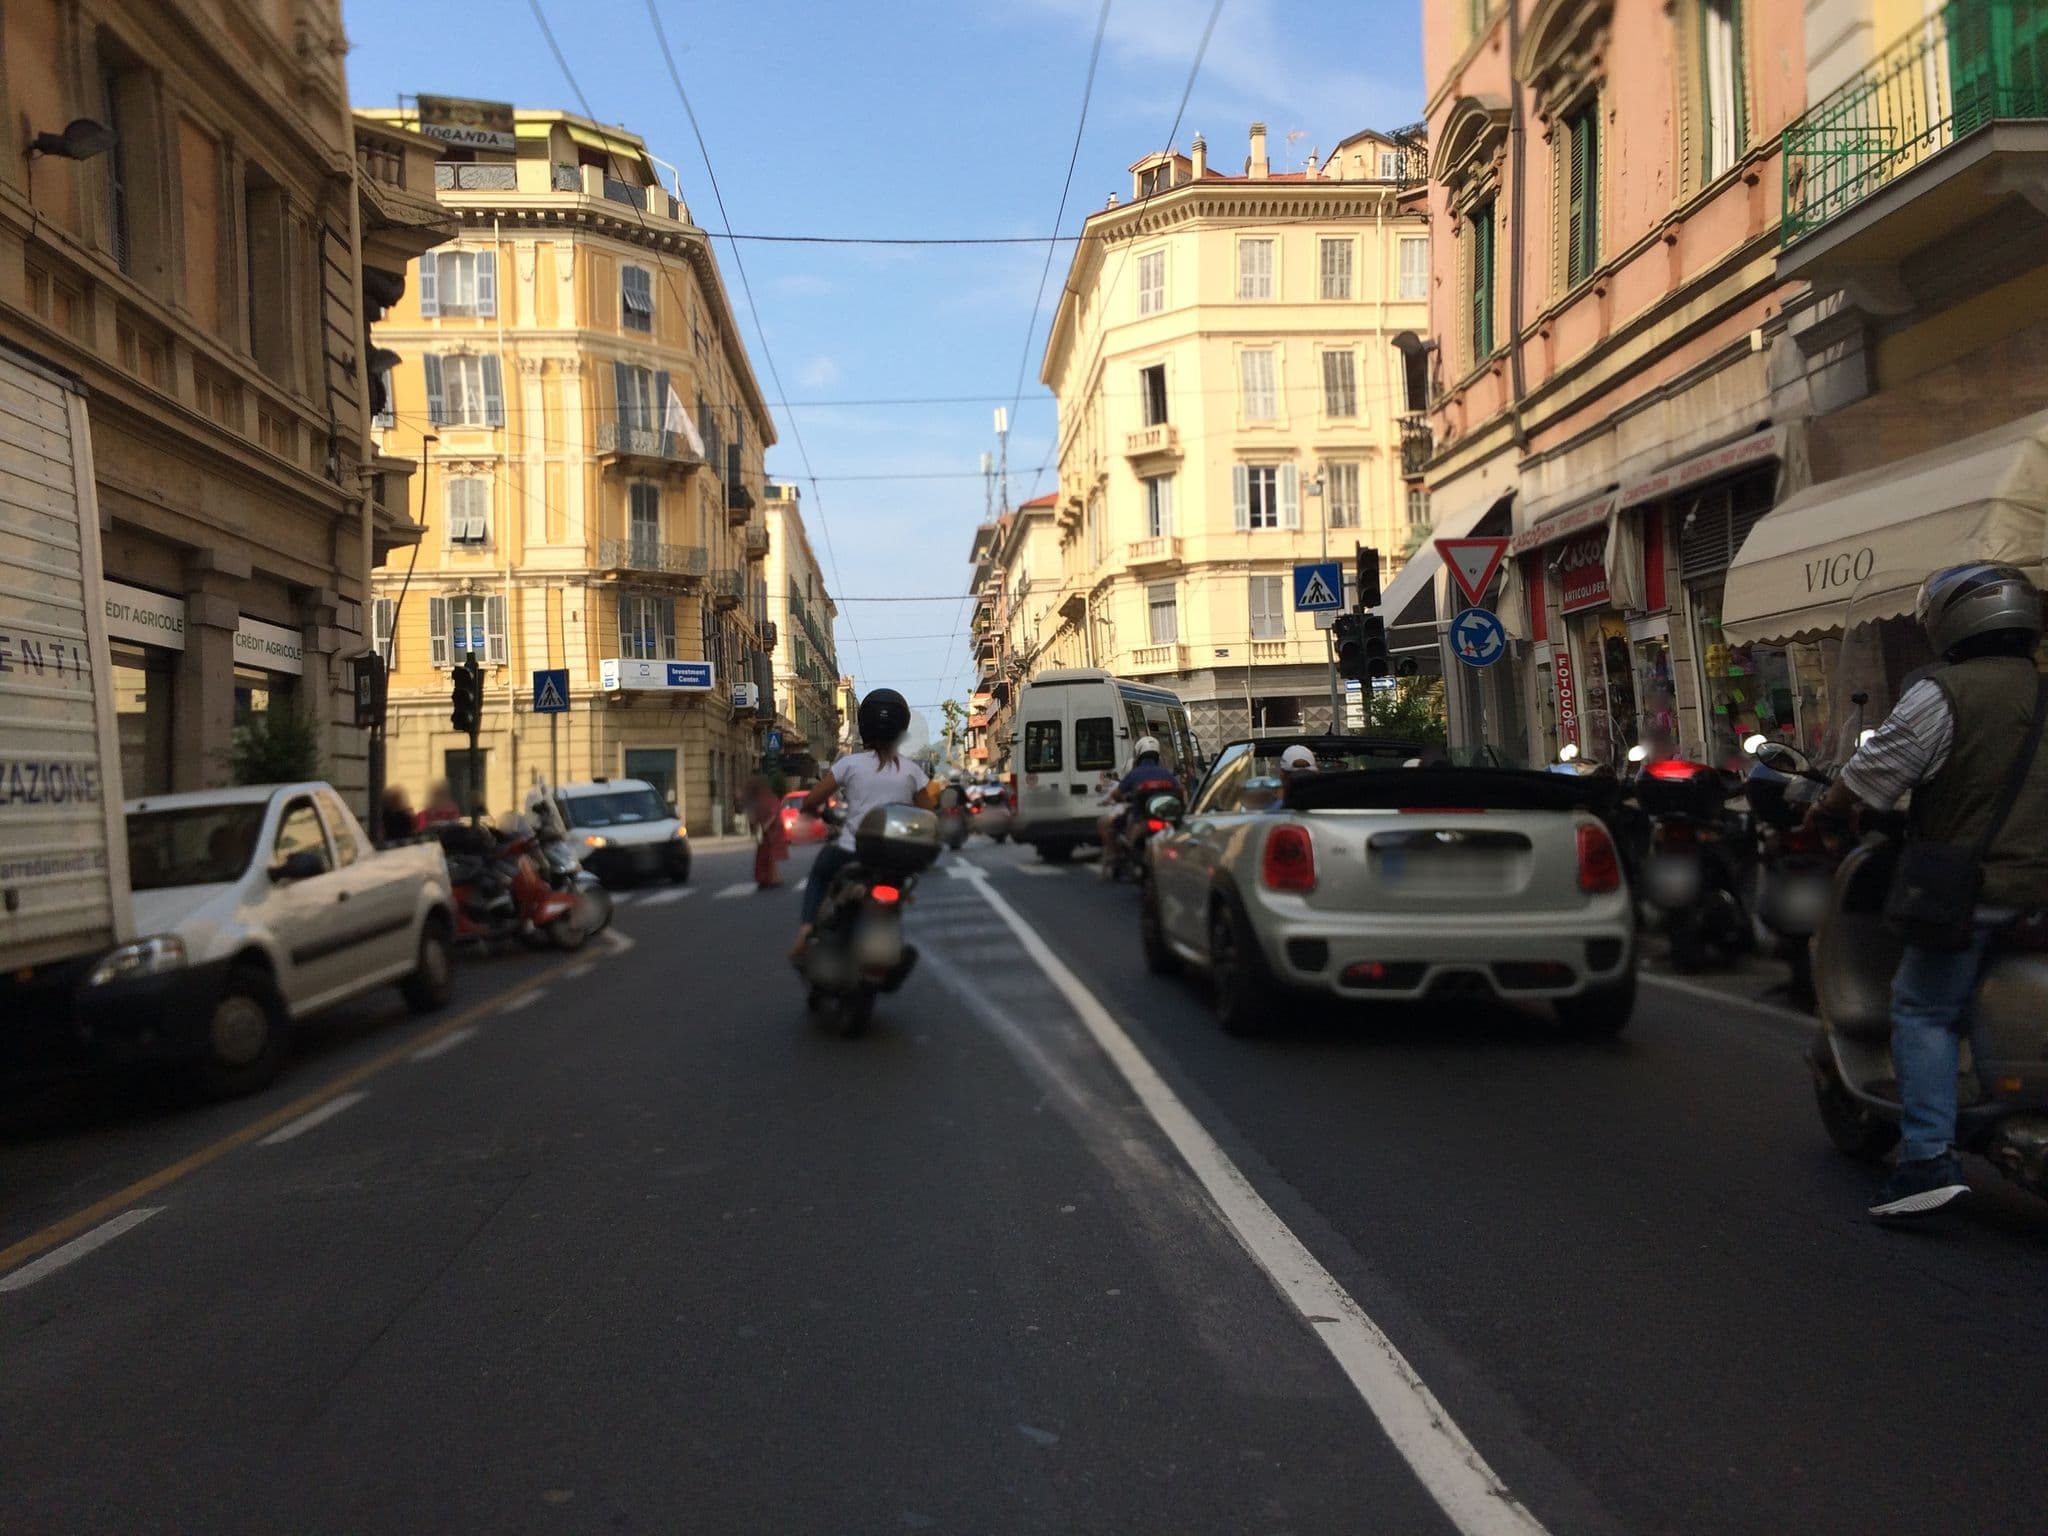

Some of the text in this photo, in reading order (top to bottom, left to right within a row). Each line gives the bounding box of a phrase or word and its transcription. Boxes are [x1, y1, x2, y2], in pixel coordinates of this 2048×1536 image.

[1805, 547, 1874, 593] VIGO
[1564, 586, 1592, 602] ARTICOLI
[132, 608, 184, 633] AGRICOLE
[235, 632, 302, 661] CRÉDIT AGRICOLE
[672, 667, 706, 676] Investment
[1558, 657, 1578, 745] FOTOCOPI
